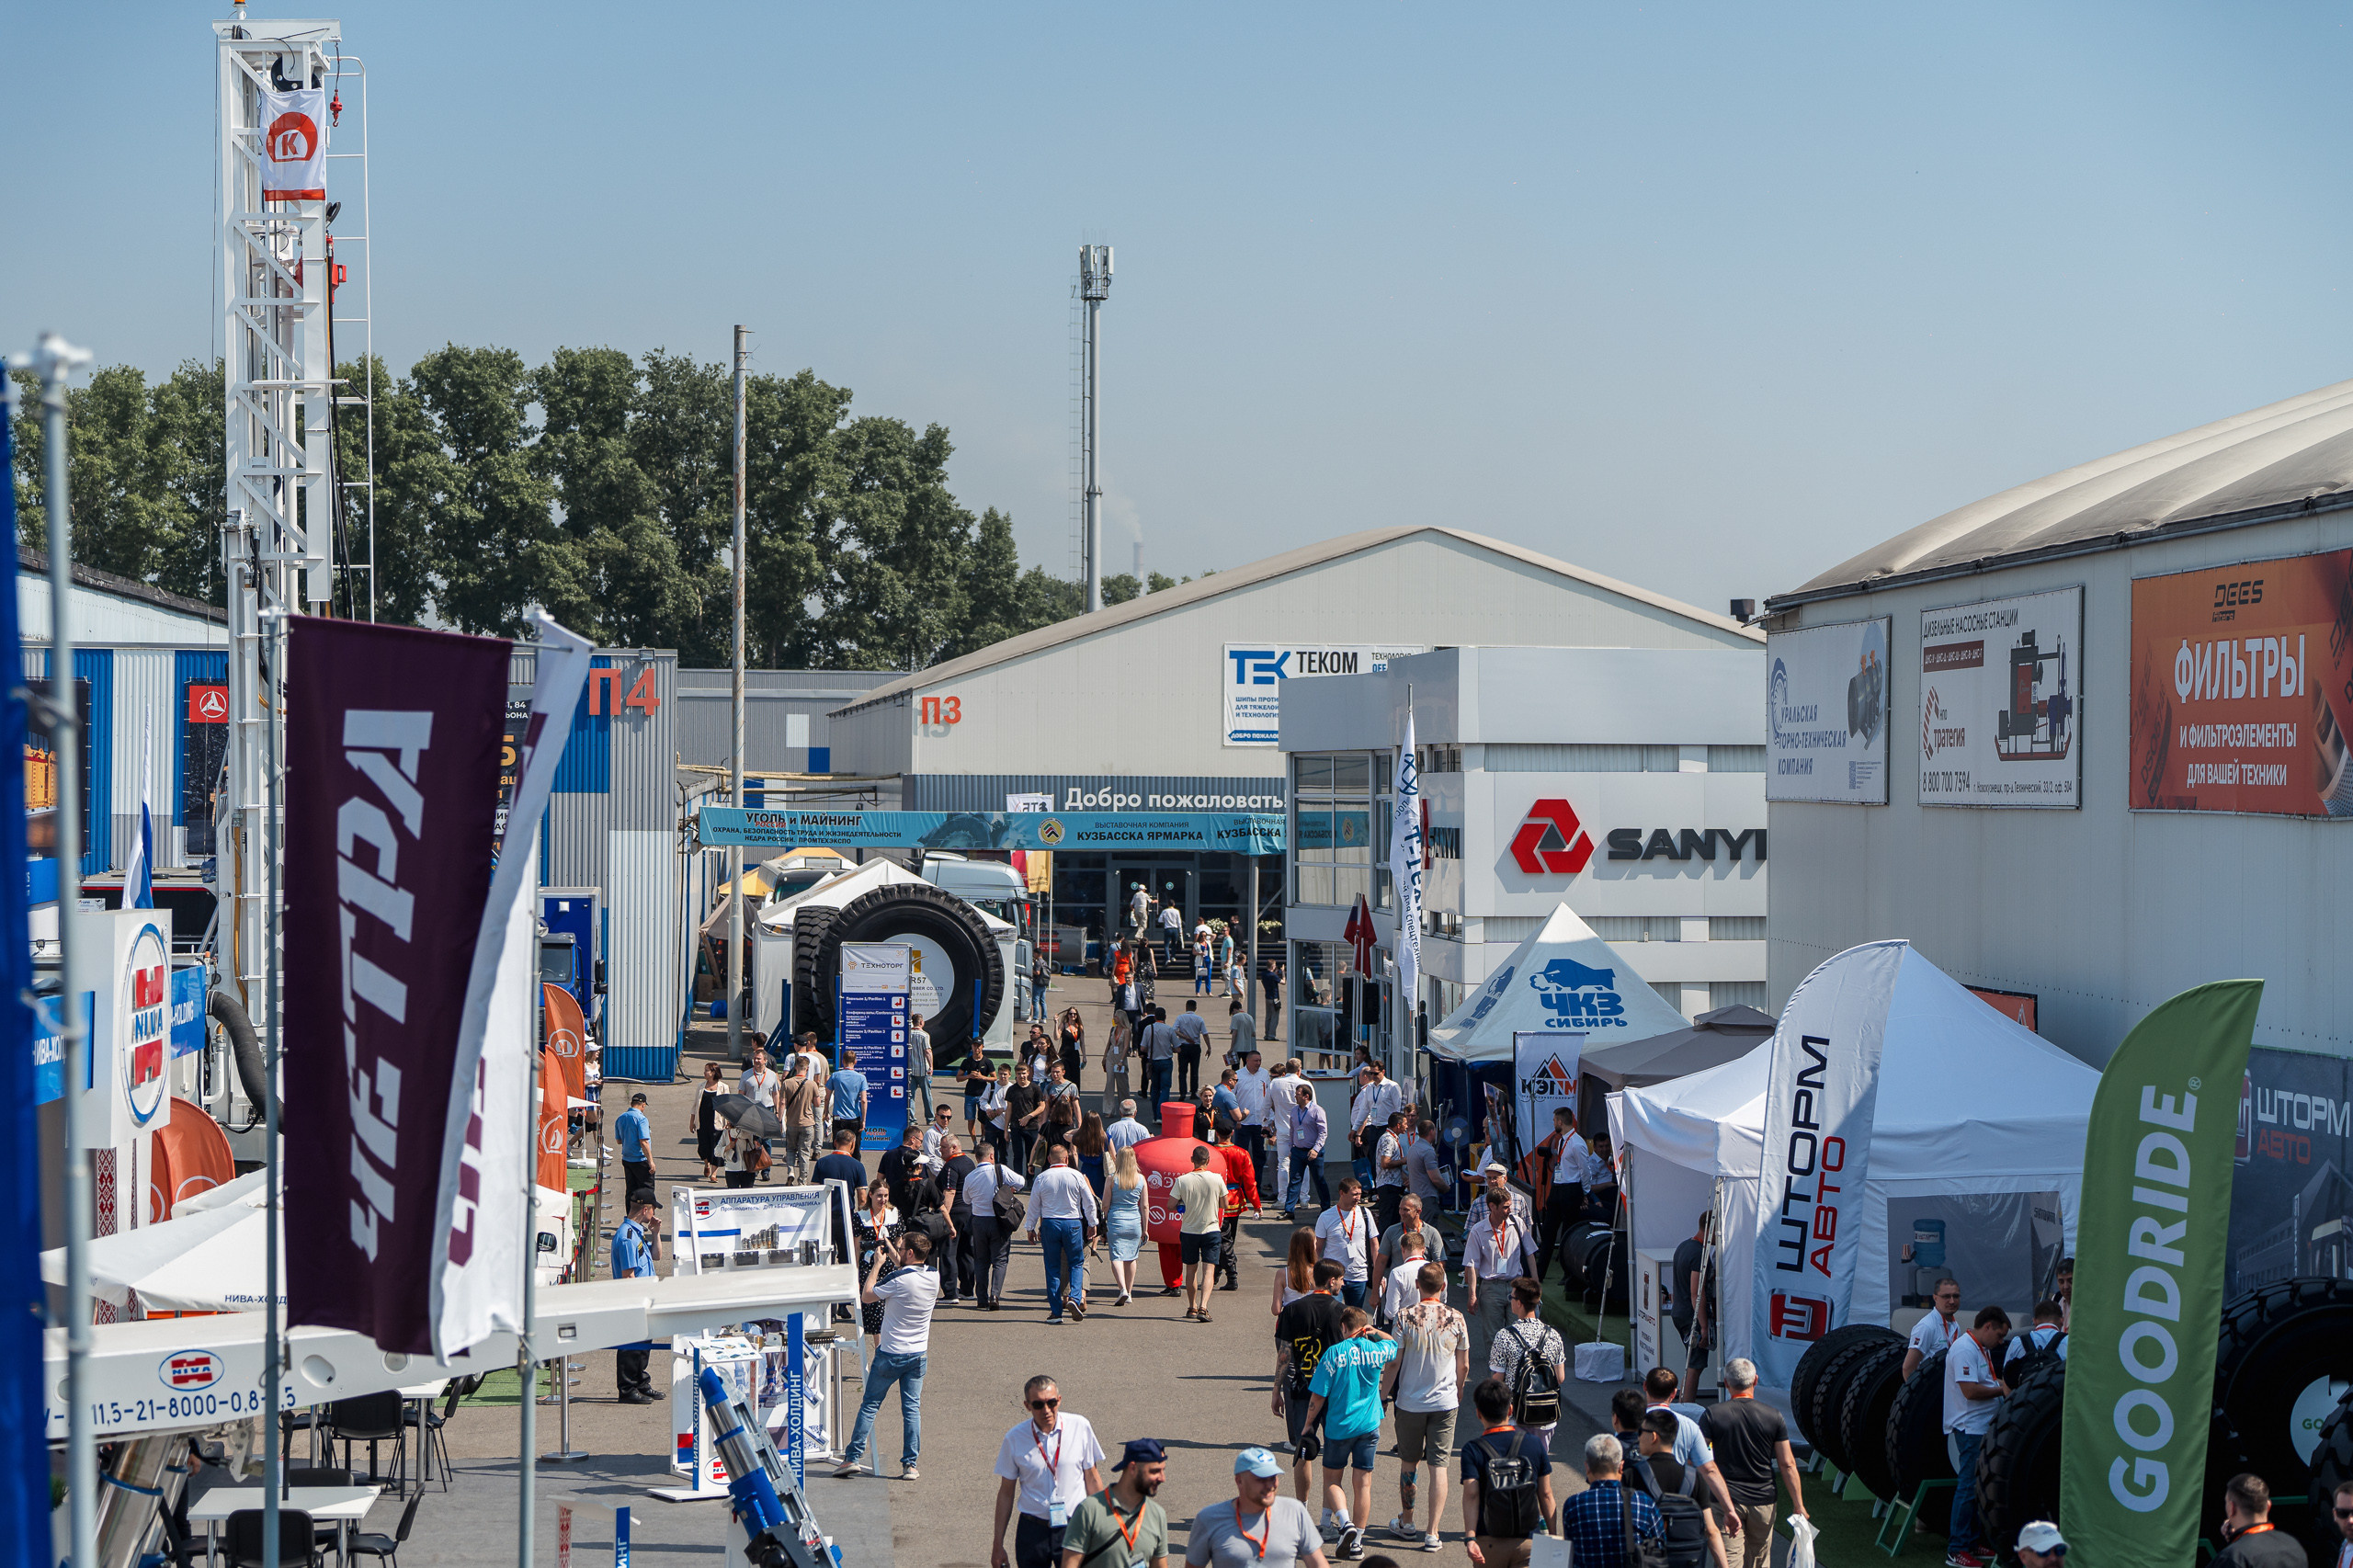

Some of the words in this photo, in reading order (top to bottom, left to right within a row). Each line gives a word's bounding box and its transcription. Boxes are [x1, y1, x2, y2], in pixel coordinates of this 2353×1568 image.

[2214, 580, 2264, 608] DEES
[1923, 618, 1954, 640] ДИЗЕЛЬНЫЕ
[1955, 613, 1987, 634] НАСОСНЫЕ
[1988, 608, 2018, 629] СТАНЦИИ
[1296, 652, 1358, 674] ТЕКОМ
[2175, 634, 2305, 703] ФИЛЬТРЫ
[589, 668, 660, 715] П4
[921, 697, 961, 724] П3
[1780, 704, 1817, 724] УРАЛЬСКАЯ
[1779, 732, 1847, 750] ГОРНО-ТЕХНИЧЕСКАЯ
[2179, 725, 2188, 748] И
[2188, 722, 2297, 748] ФИЛЬТРОЭЛЕМЕНТЫ
[1778, 758, 1813, 776] КОМПАНИЯ
[2187, 764, 2205, 788] ДЛЯ
[2207, 759, 2239, 785] ВАШЕЙ
[2241, 764, 2287, 786] ТЕХНИКИ
[1923, 772, 1927, 792] 8
[1928, 772, 1940, 792] 800
[1941, 771, 1953, 792] 700
[1065, 787, 1142, 812] Добро
[745, 812, 785, 824] УГОЛЬ
[801, 812, 862, 826] МАЙНИНГ
[824, 830, 902, 838] ЖИЗНЕДЕЯТЕЛЬНОСТИ
[1077, 832, 1142, 840] КУЗБАССКА
[1147, 832, 1203, 840] ЯРМАРКА
[1217, 828, 1281, 839] КУЗБАССКА
[1540, 993, 1625, 1017] ЧКЗ
[134, 1008, 163, 1040] NIVA
[1545, 1018, 1627, 1028] СИБИРЬ
[2257, 1087, 2350, 1137] ШТОРМ
[1776, 1034, 1830, 1273] ШТОРМ
[2256, 1129, 2311, 1165] АВТО
[721, 1195, 770, 1204] АППАРАТУРА
[772, 1192, 820, 1202] УПРАВЛЕНИЯ
[1810, 1136, 1846, 1278] АВТО
[172, 1366, 211, 1376] NIVA
[789, 1370, 803, 1478] НИВА-ХОЛДИНГ
